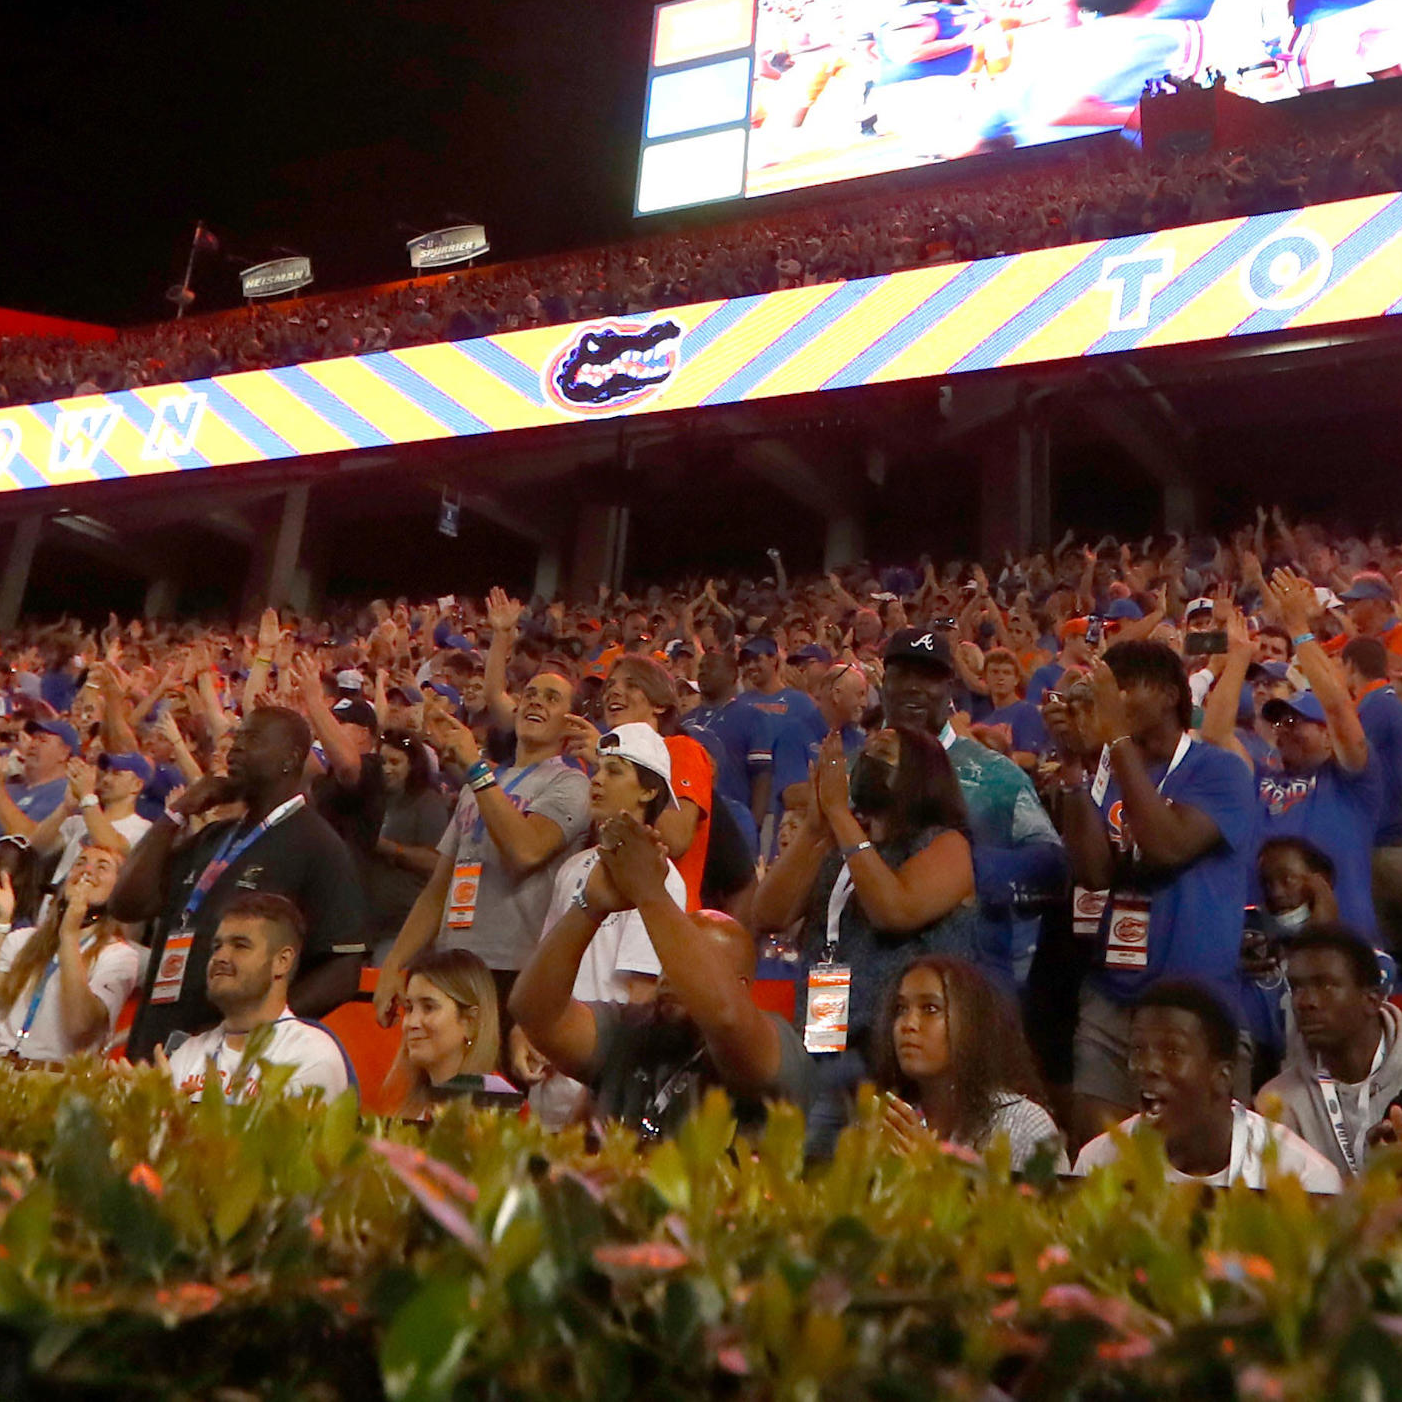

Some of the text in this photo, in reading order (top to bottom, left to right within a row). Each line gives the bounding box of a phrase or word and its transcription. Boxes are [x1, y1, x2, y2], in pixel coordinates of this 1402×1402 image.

[420, 241, 473, 258] SPURRIER
[245, 270, 304, 289] HEISMAN
[910, 633, 934, 651] A
